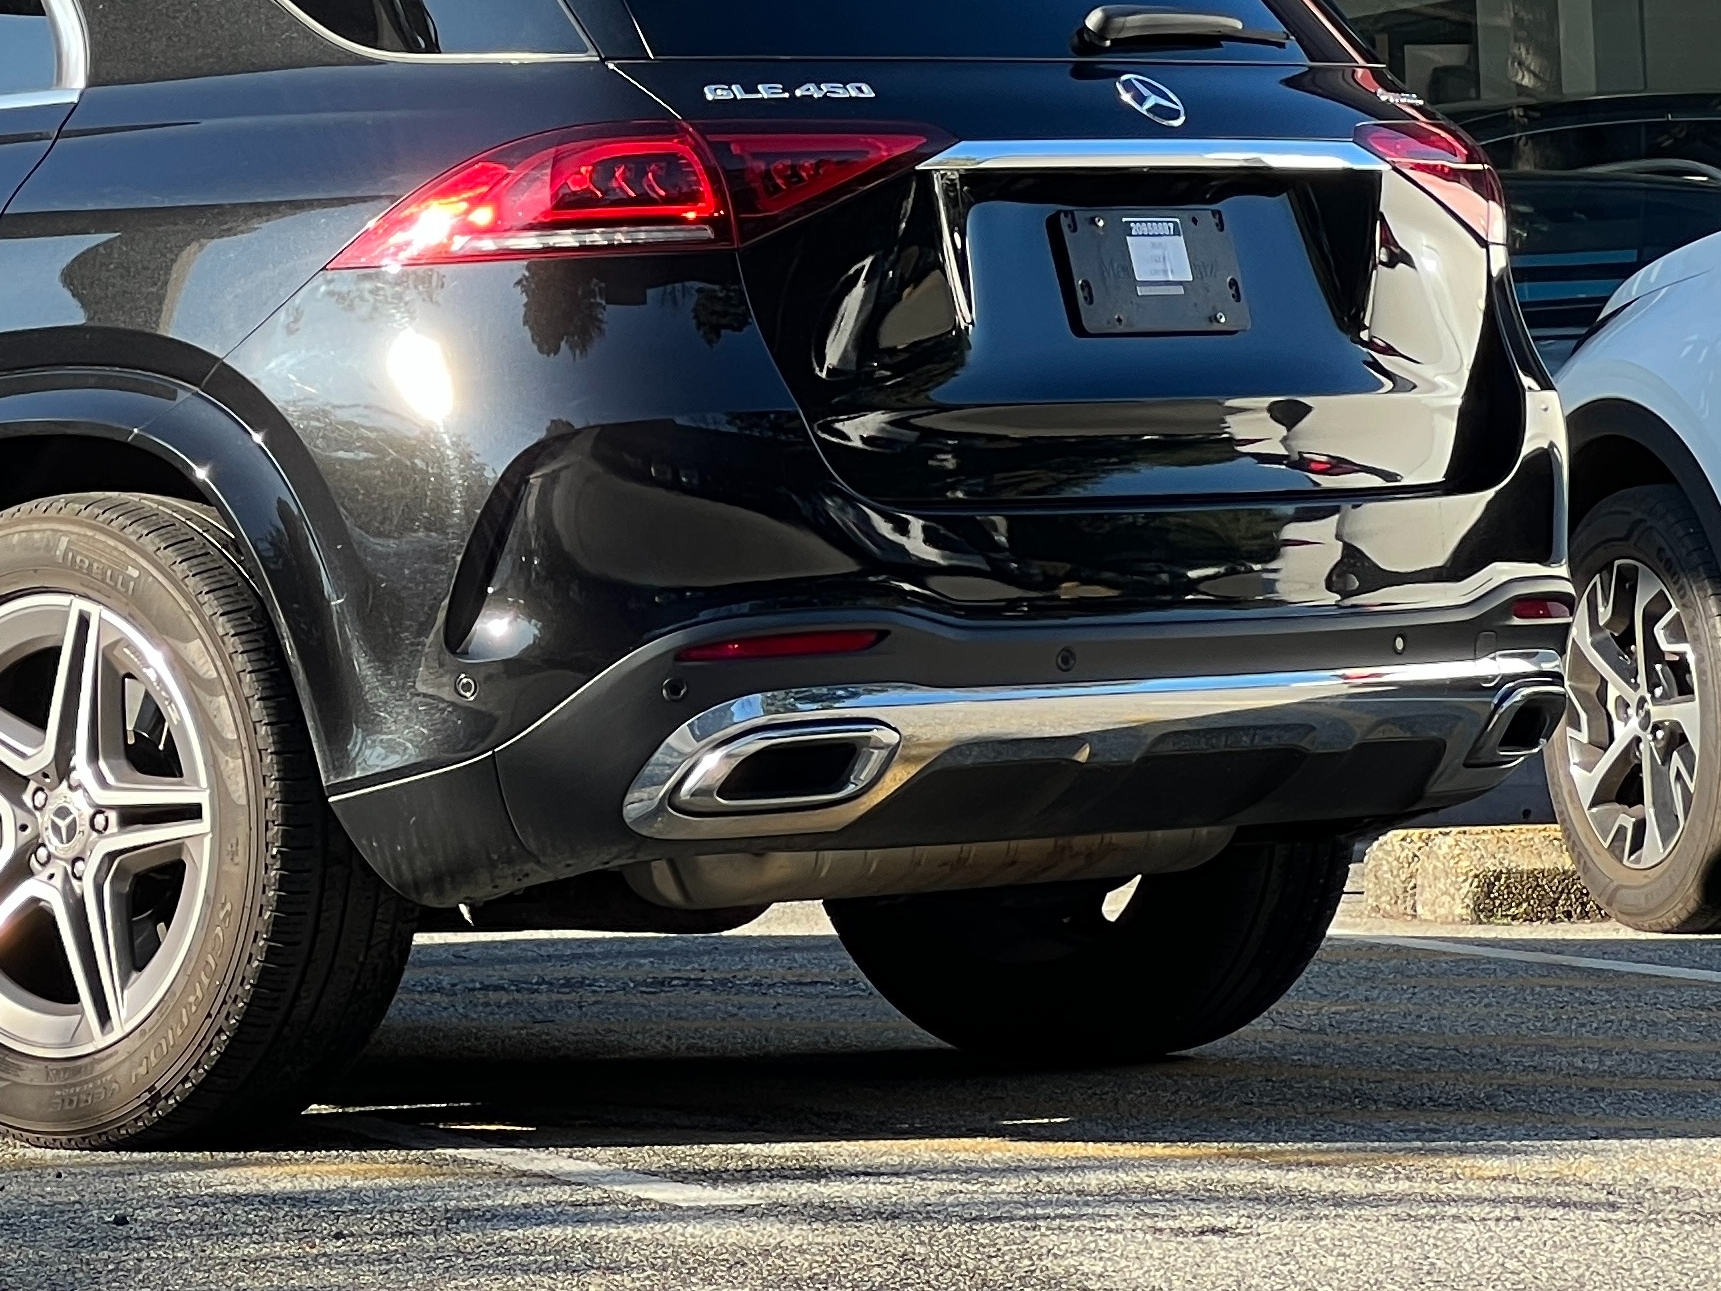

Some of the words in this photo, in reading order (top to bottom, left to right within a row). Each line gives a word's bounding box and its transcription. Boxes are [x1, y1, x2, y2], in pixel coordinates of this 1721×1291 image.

[703, 83, 790, 101] GLE
[794, 81, 876, 99] 450
[55, 535, 140, 597] PIRELLI
[131, 894, 233, 1085] SCORPION
[51, 1079, 122, 1112] VERDE
